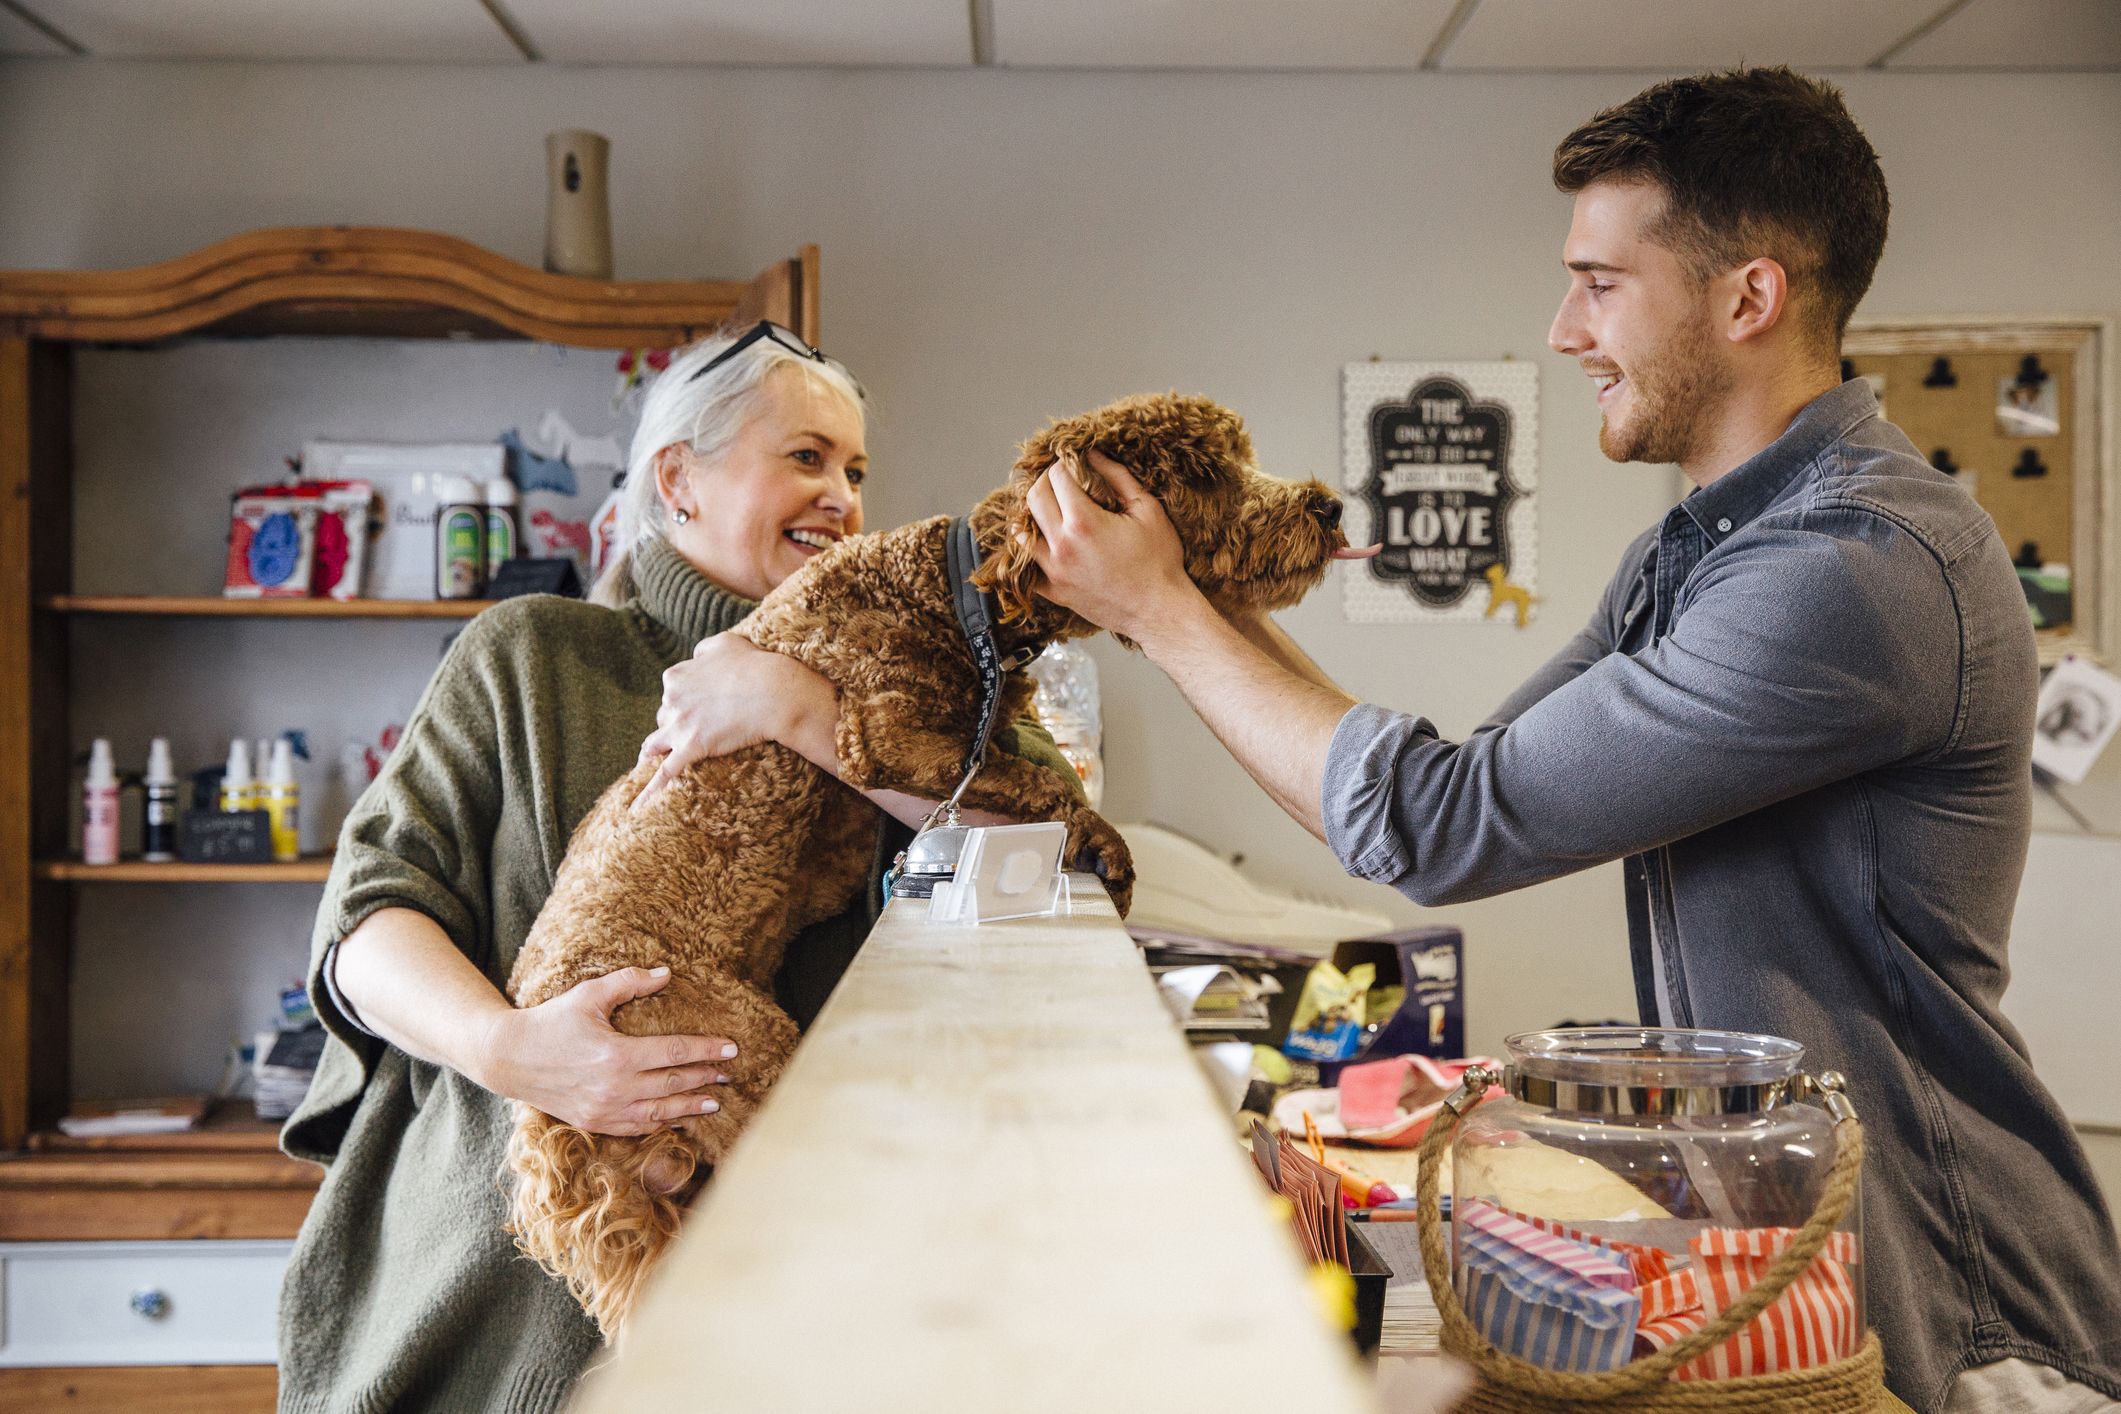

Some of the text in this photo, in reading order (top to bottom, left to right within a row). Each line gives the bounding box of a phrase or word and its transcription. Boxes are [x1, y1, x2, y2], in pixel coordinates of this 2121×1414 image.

[1421, 398, 1464, 424] THE
[1388, 506, 1492, 545] LOVE
[1409, 547, 1472, 573] WHAT
